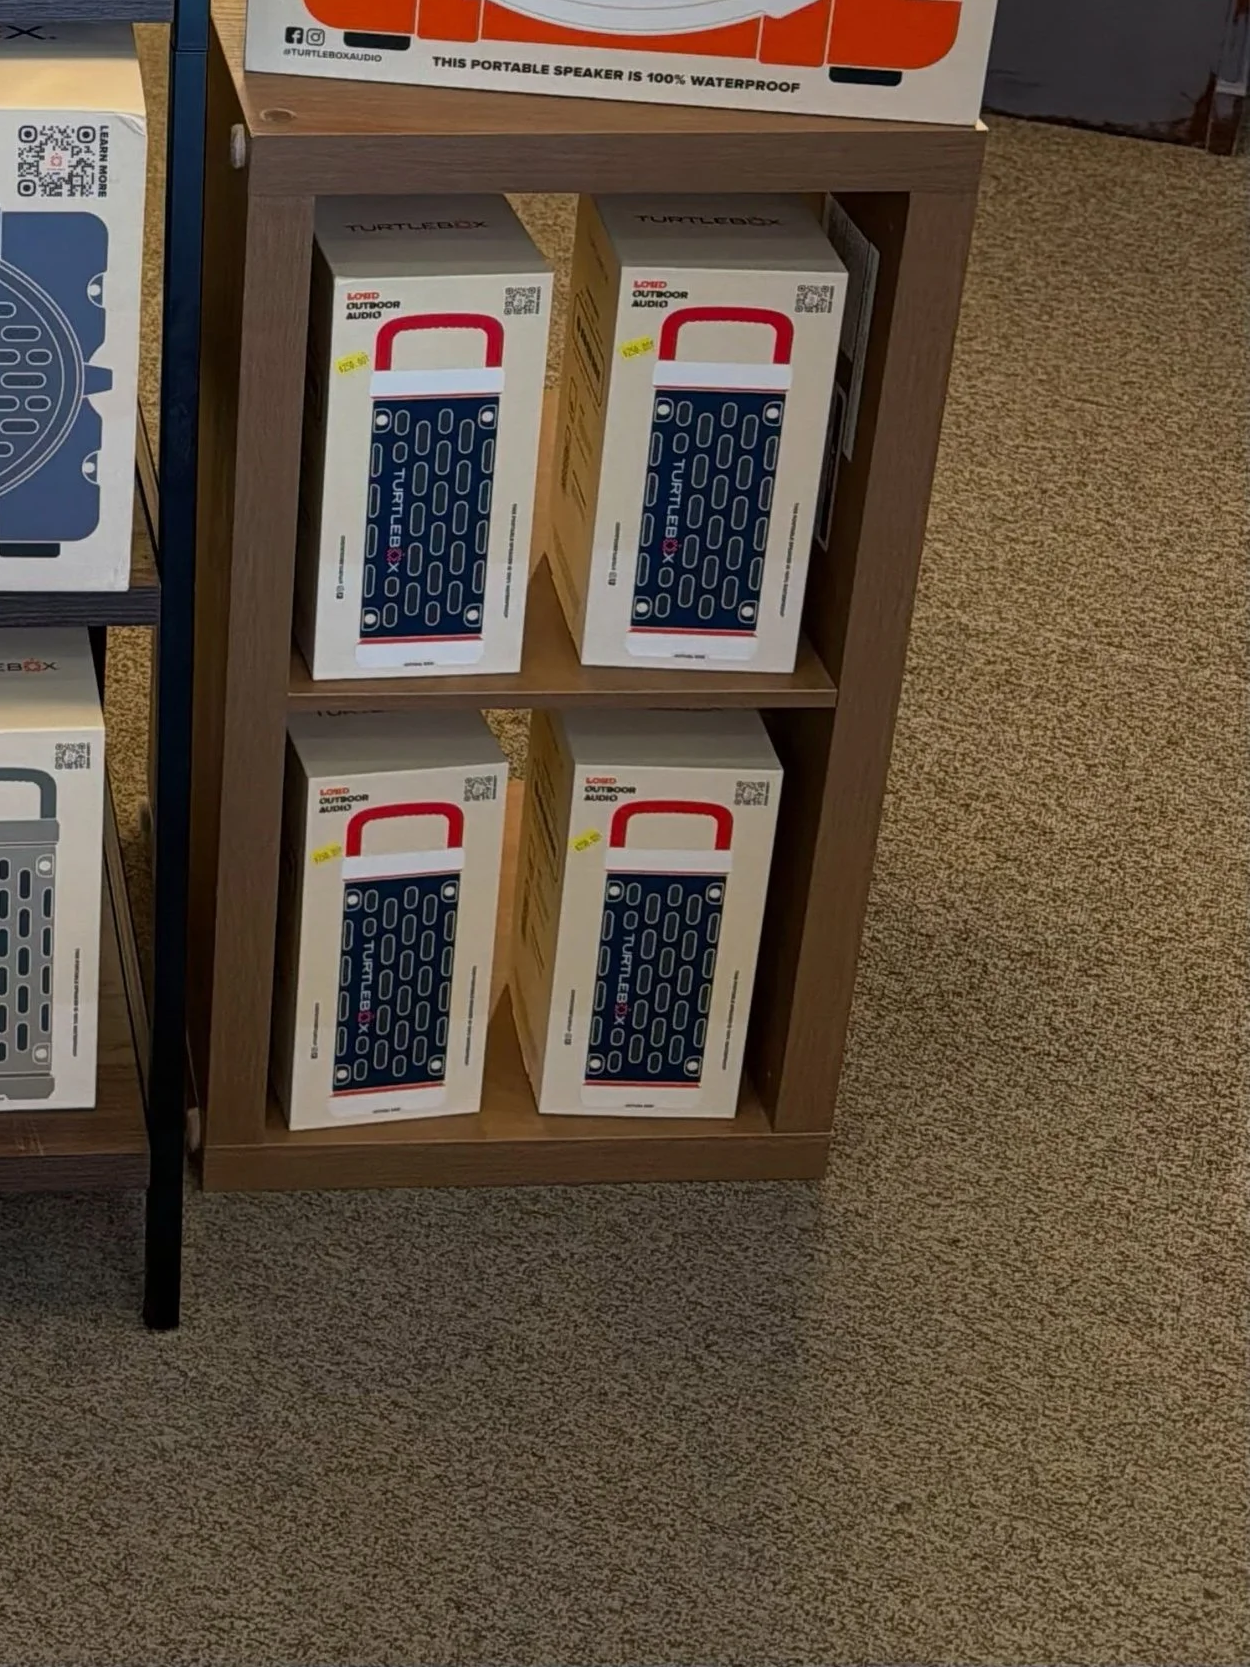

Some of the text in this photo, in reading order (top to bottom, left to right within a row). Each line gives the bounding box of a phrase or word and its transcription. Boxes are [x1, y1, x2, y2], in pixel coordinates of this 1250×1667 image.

[282, 47, 382, 64] @TURTLEBOXAUDIO
[432, 55, 801, 94] THIS PORTABLE SPEAKER IS 100% WATERPROOF
[97, 125, 109, 198] LEARN MORE
[344, 218, 489, 233] TURTLEBOX
[345, 310, 382, 321] AUDIO
[346, 300, 401, 311] OUTDOOR
[347, 291, 380, 301] LOUD
[385, 466, 406, 574] TURTLEBOX
[661, 457, 682, 564] TURTLEBOX
[357, 939, 375, 1034] TURTLEBOX
[614, 933, 635, 1027] TURTLEBOX
